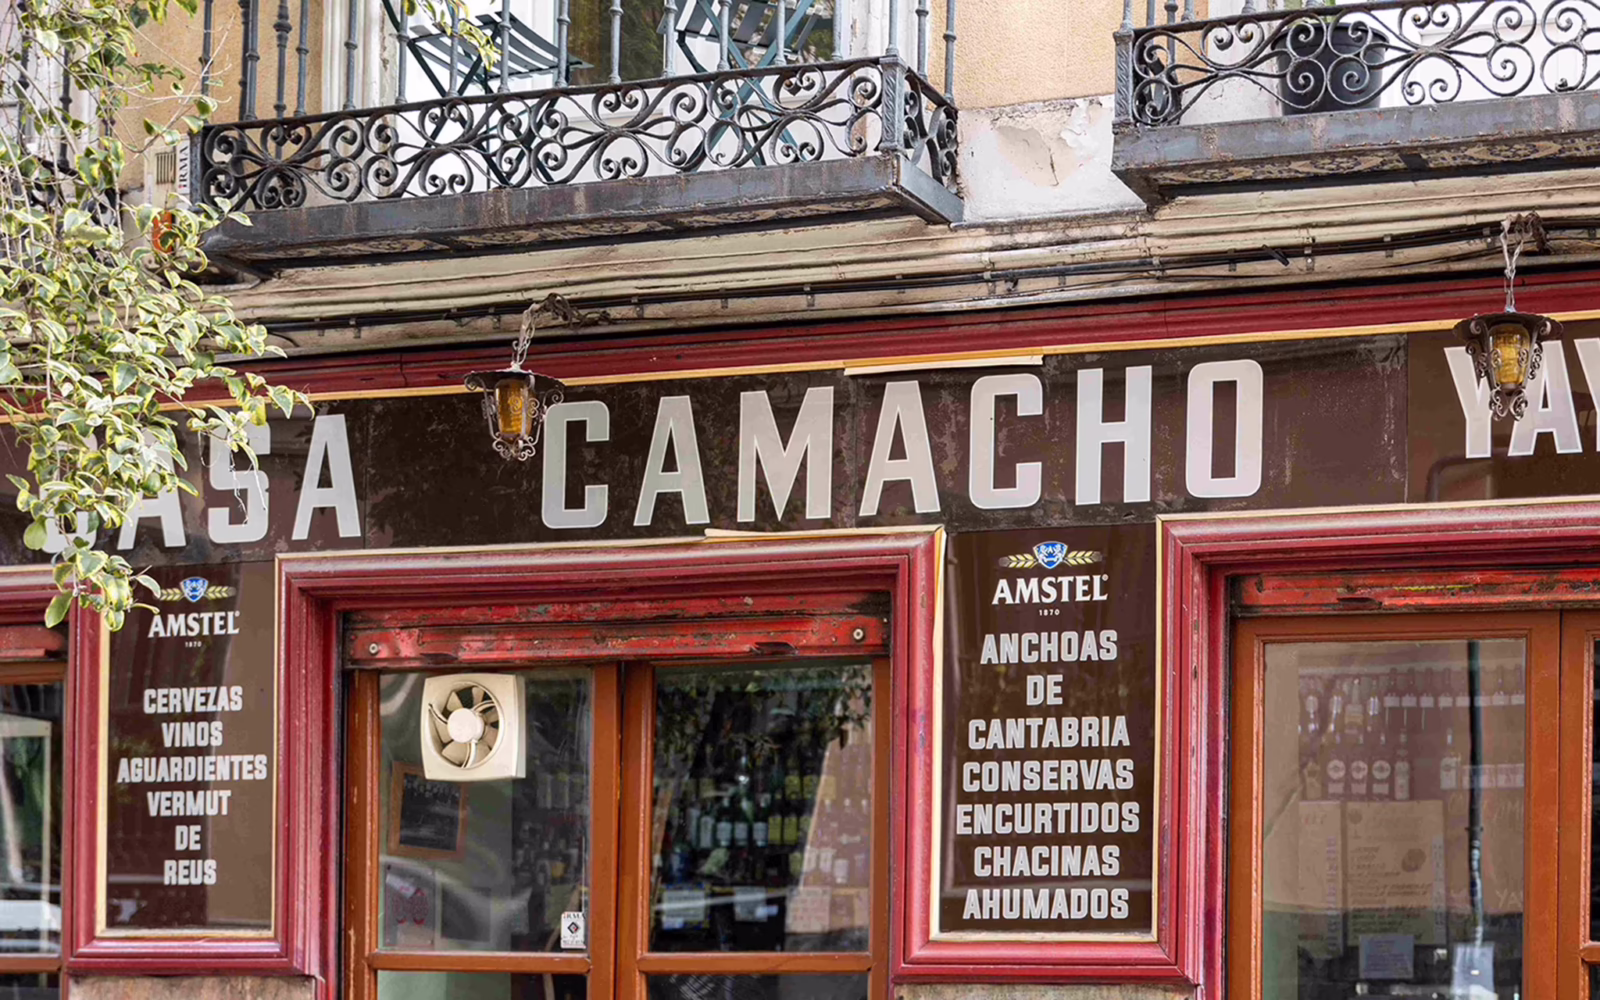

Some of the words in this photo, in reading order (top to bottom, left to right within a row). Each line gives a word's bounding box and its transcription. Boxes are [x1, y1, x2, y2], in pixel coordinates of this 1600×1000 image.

[541, 359, 1264, 529] CAMACHO
[1038, 608, 1060, 616] 1870
[980, 629, 1118, 665] ANCHOAS
[143, 685, 243, 714] CERVEZAS
[1026, 674, 1063, 706] DE
[161, 721, 223, 748] VINOS
[968, 715, 1130, 750] CANTABRIA
[117, 754, 268, 783] AGUARDIENTES
[962, 758, 1134, 792] CONSERVAS
[147, 790, 232, 816] VERMUT
[956, 801, 1140, 835] ENCURTIDOS
[175, 825, 201, 850] DE
[164, 859, 217, 885] REUS
[974, 845, 1120, 877] CHACINAS
[962, 888, 1129, 920] AHUMADOS
